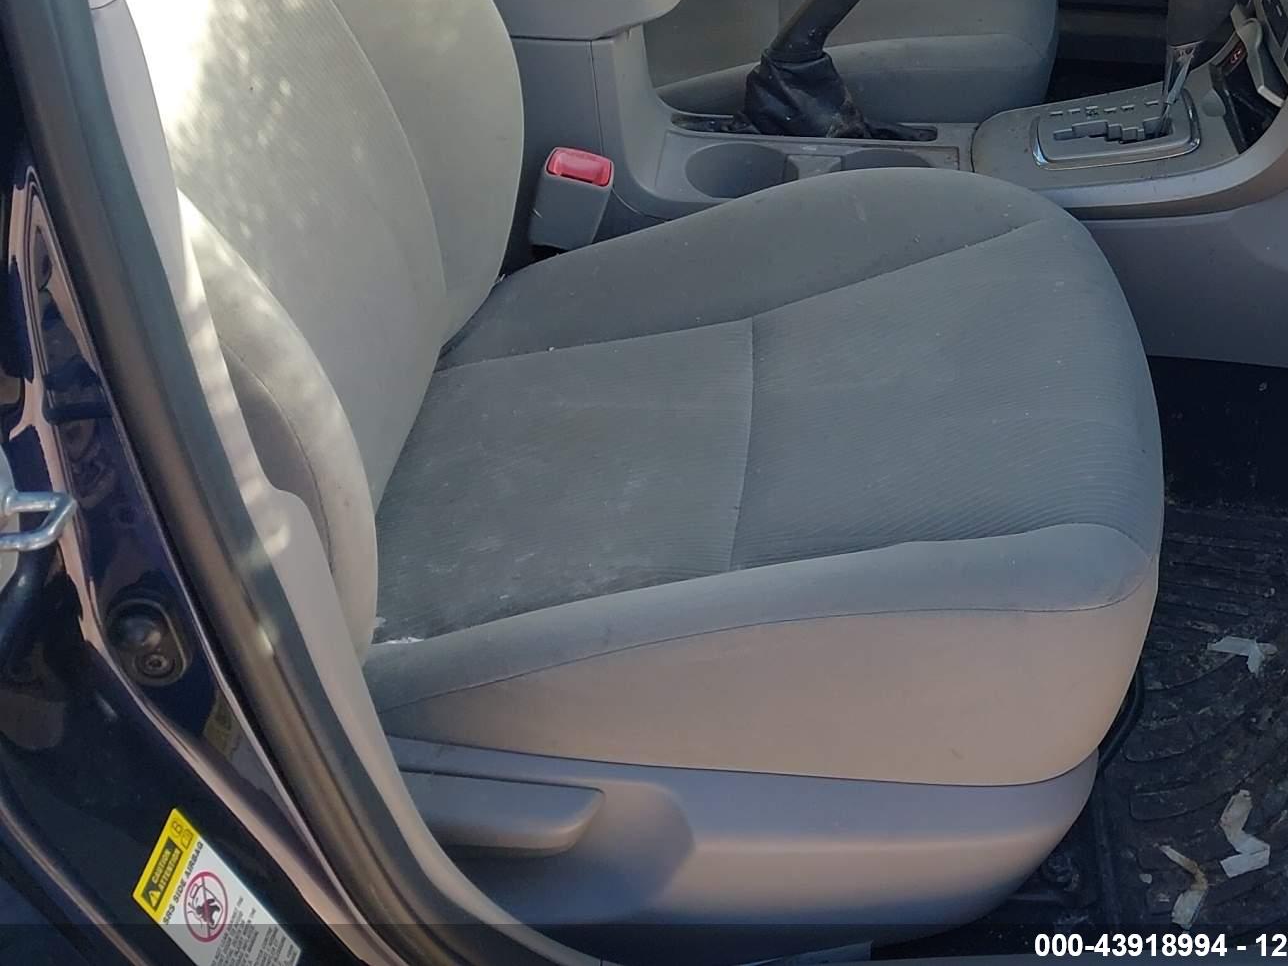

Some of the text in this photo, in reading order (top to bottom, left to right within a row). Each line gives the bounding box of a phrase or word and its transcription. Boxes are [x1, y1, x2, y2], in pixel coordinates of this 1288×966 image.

[152, 848, 171, 884] CAUTION
[157, 849, 181, 892] ATTENTION
[163, 841, 204, 925] SRS SIDE AIRBAG
